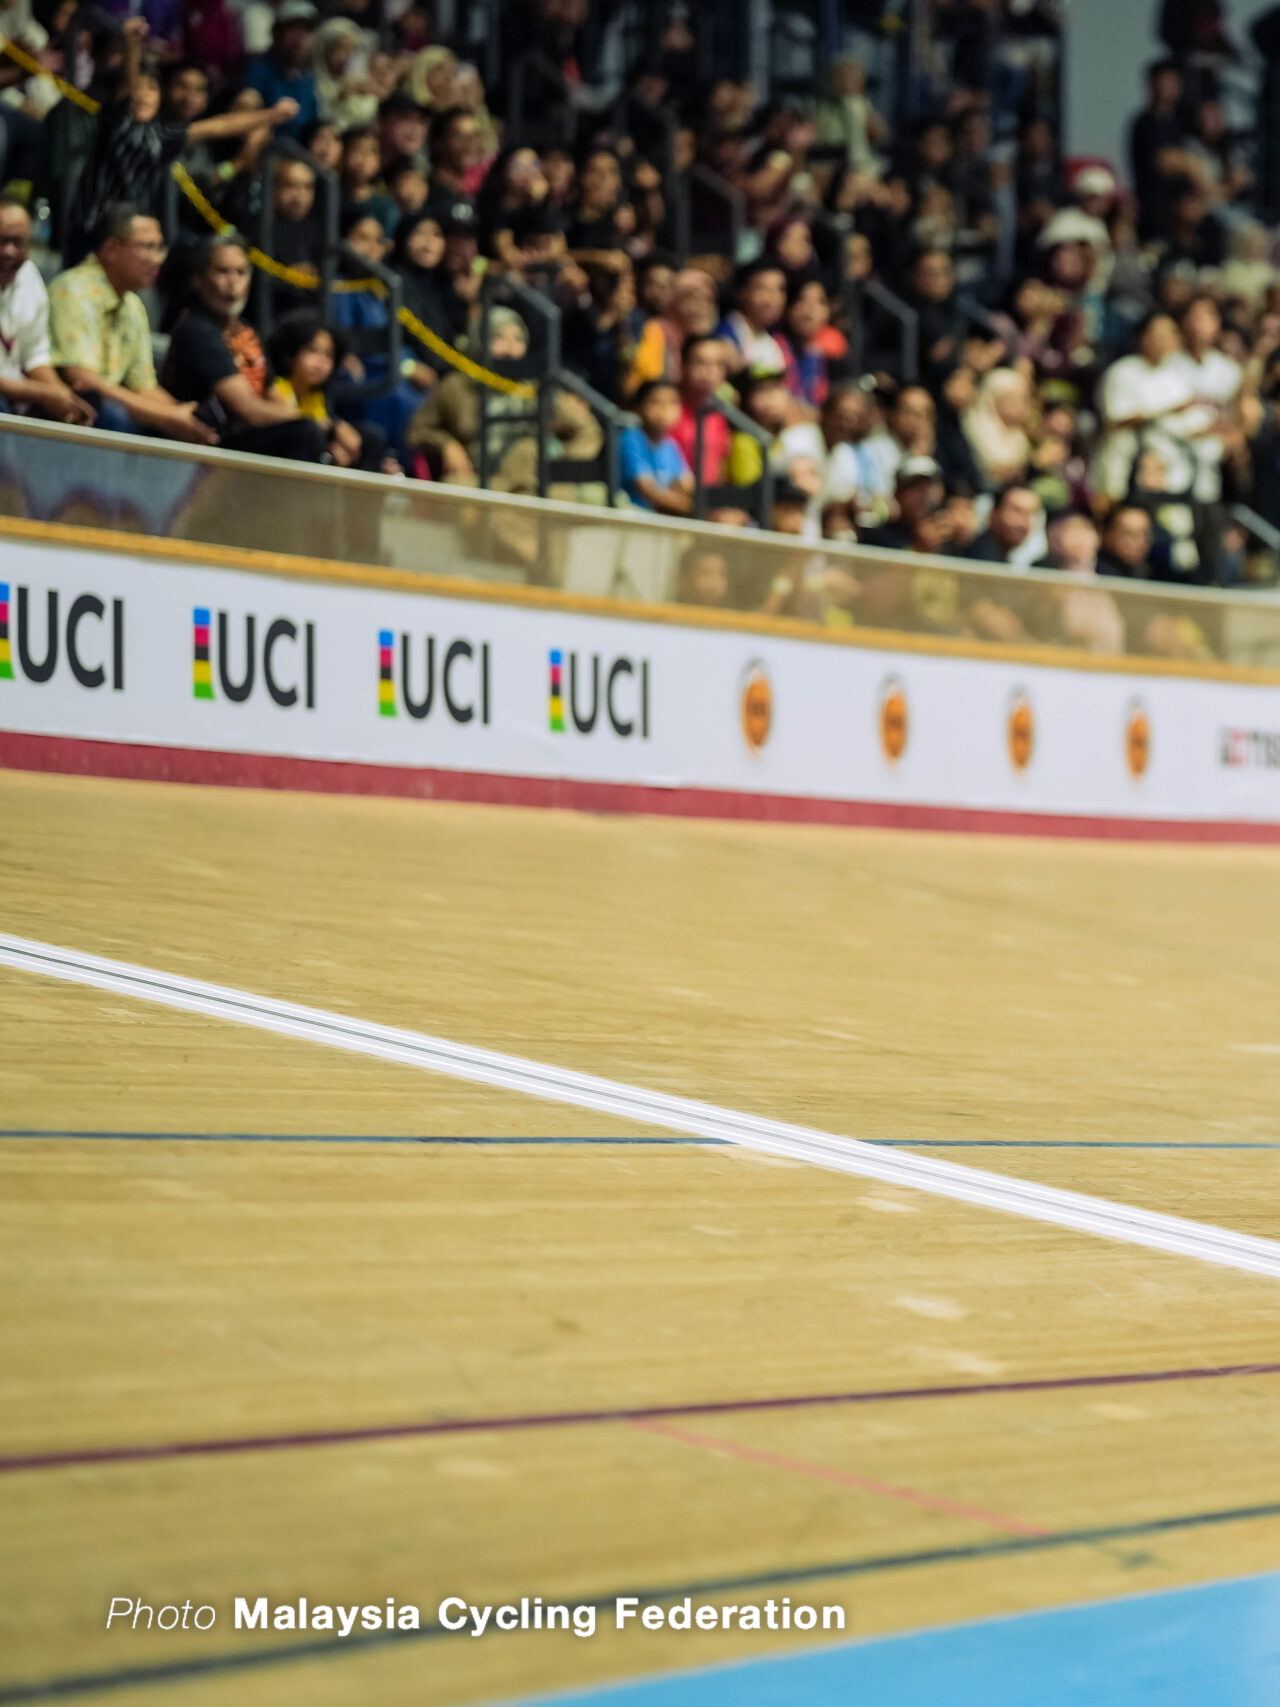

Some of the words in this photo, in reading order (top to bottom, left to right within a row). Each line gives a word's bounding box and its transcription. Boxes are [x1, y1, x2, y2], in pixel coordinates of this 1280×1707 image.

[17, 585, 125, 691] UCI
[218, 610, 317, 710] UCI
[402, 633, 490, 725] UCI
[570, 652, 649, 739] UCI
